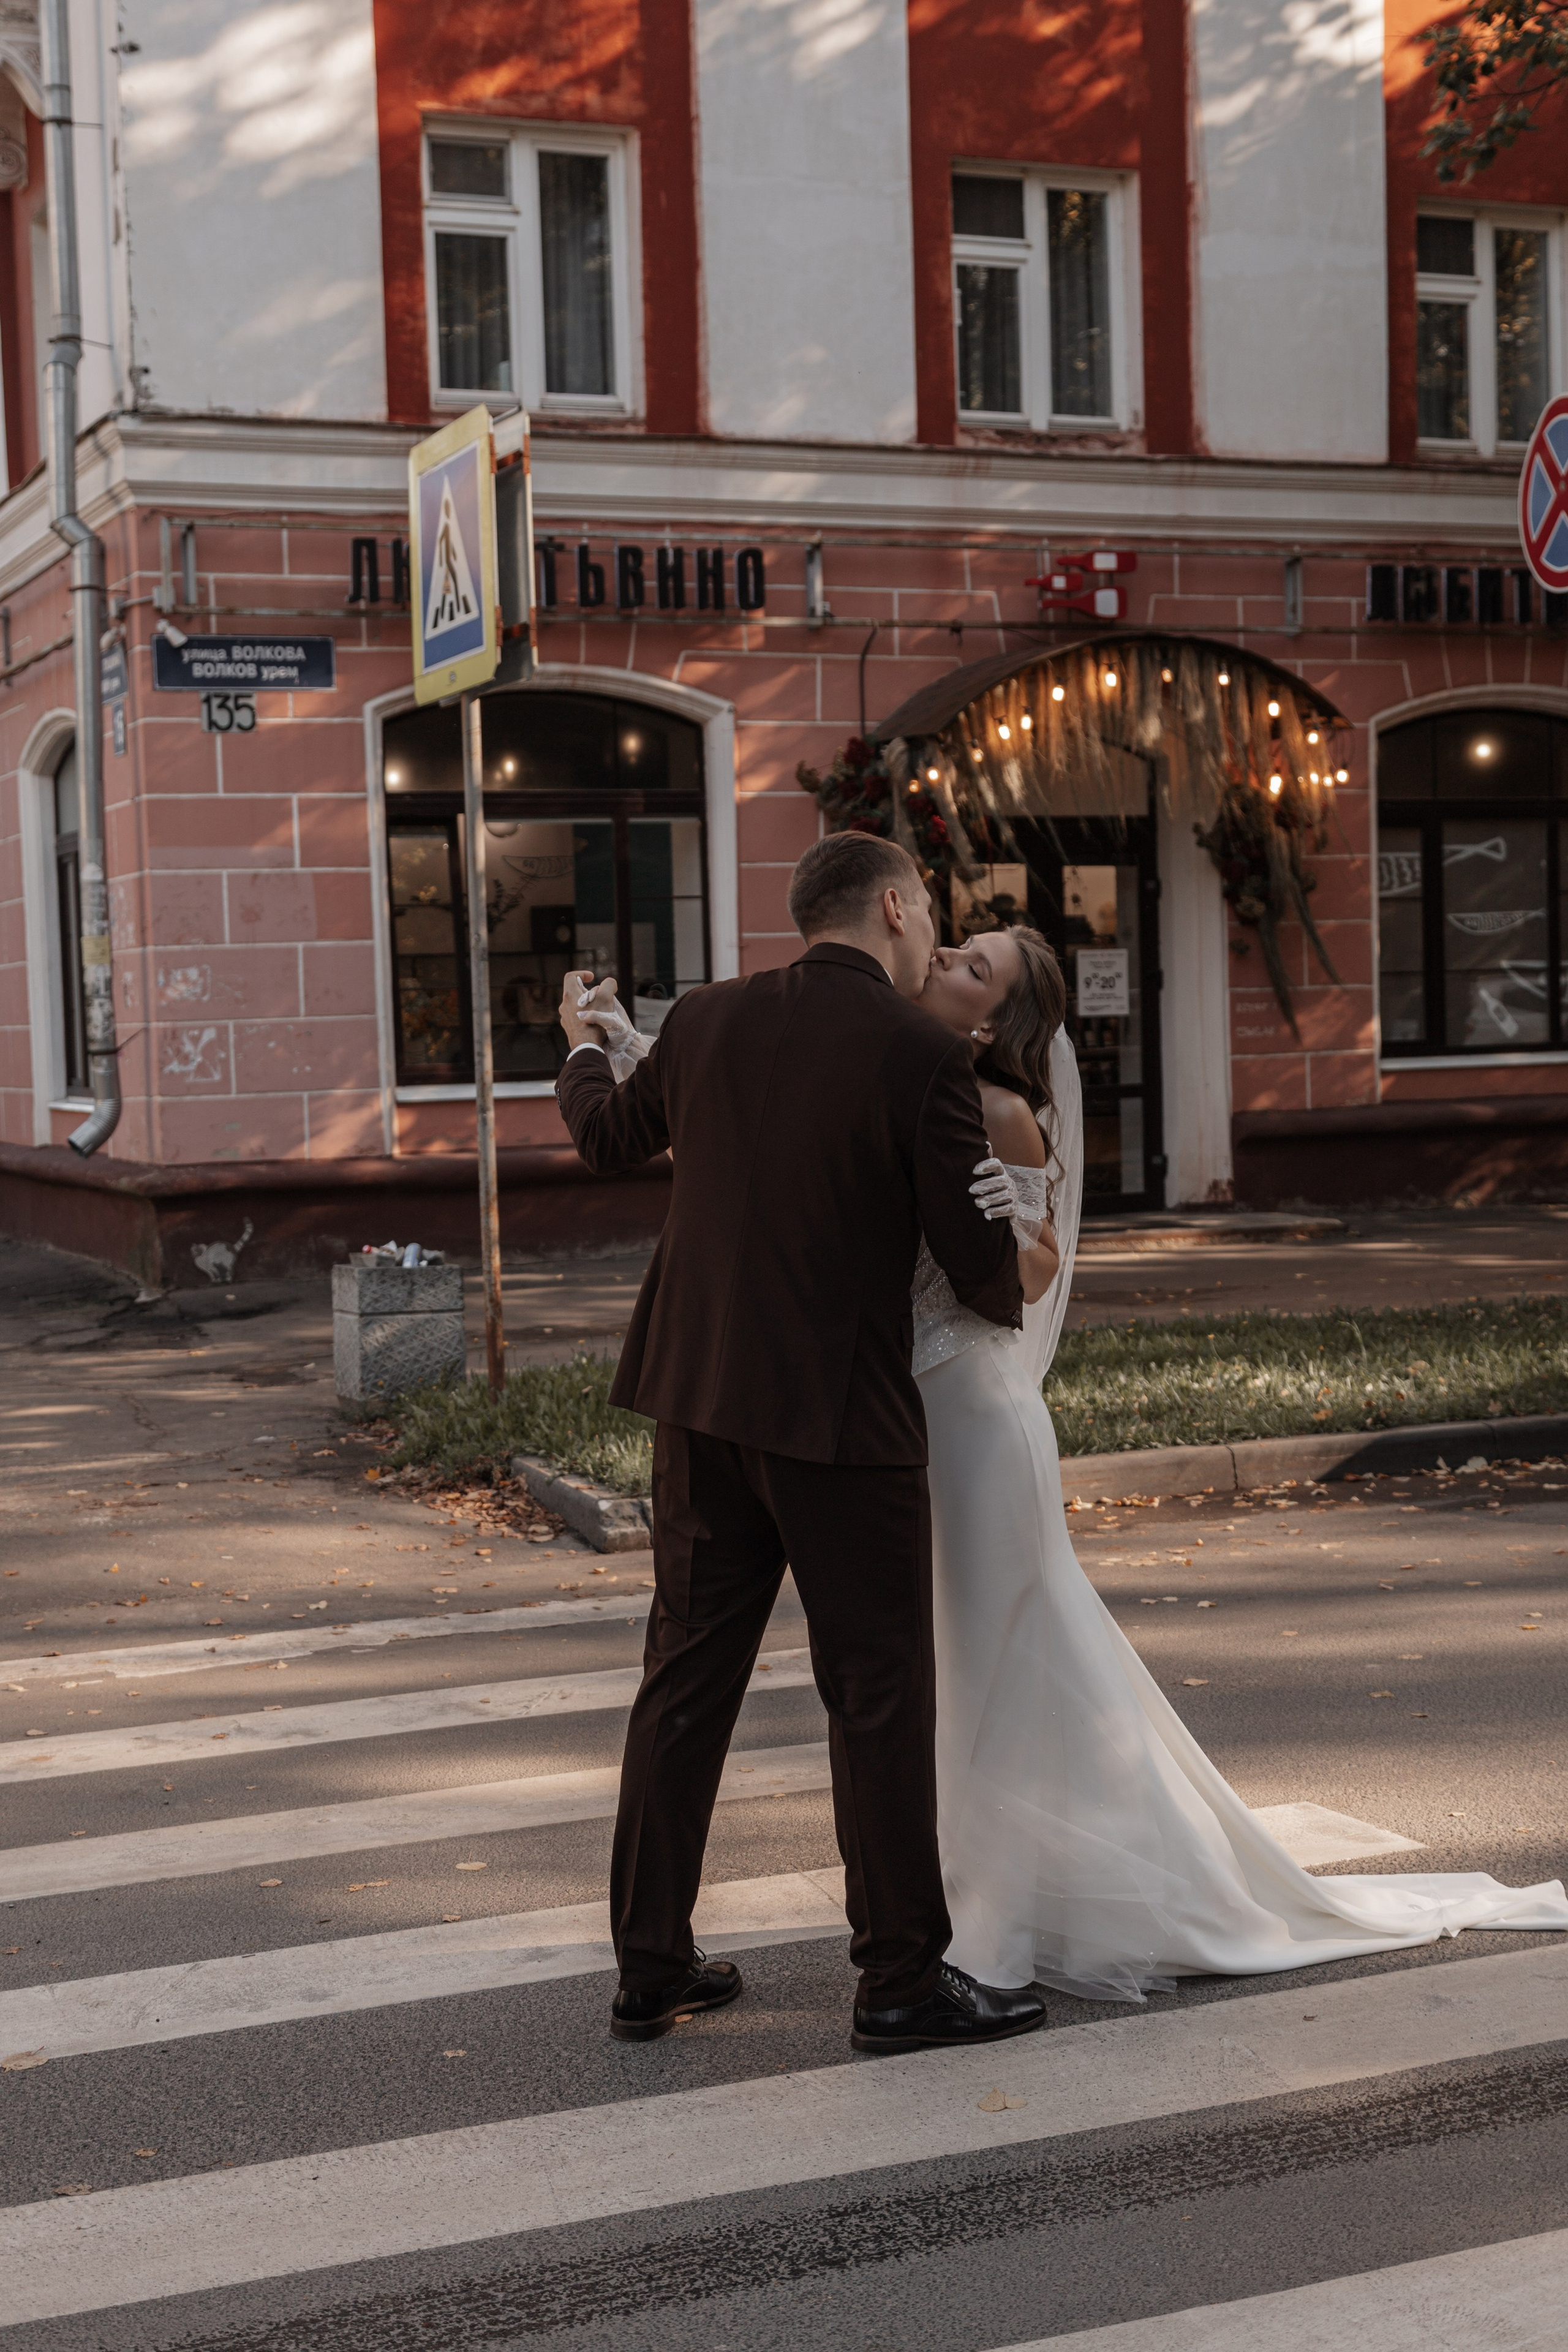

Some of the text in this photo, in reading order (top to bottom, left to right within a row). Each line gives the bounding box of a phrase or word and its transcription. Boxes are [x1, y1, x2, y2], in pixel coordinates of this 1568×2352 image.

[345, 537, 765, 610] ЛТЬВИНО
[181, 645, 306, 663] улица ВОЛКОВА
[192, 662, 258, 678] ВОЛКОВ
[202, 694, 256, 731] 135
